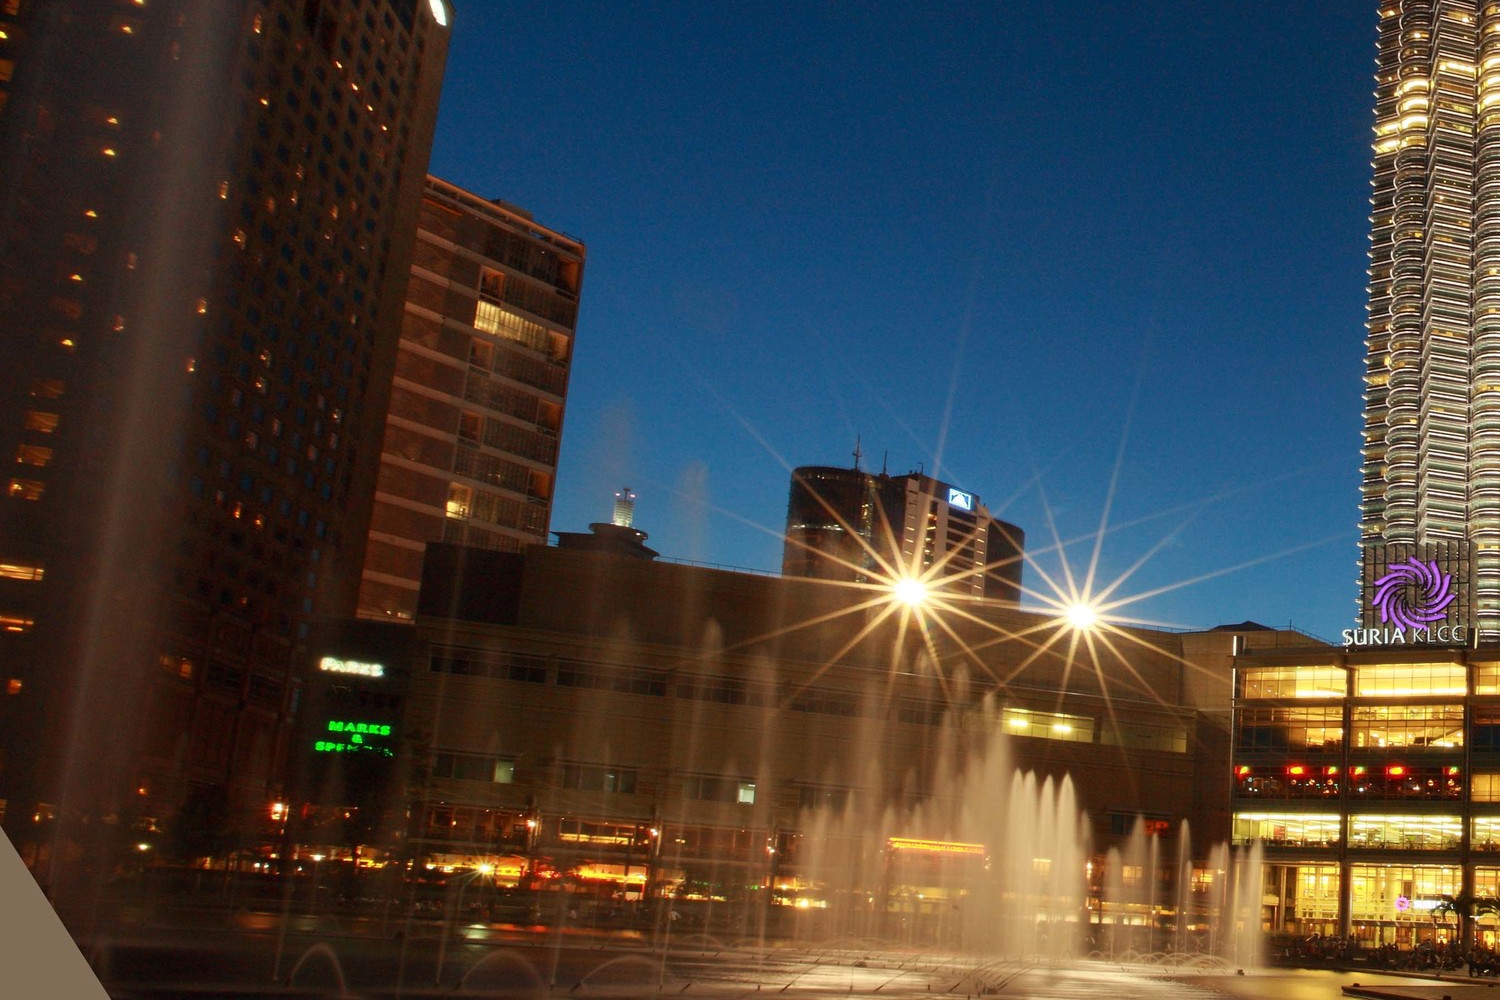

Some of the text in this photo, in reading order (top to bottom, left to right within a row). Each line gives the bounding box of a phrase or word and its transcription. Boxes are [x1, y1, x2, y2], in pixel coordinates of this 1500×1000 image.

[1342, 625, 1465, 646] SURIA KLCC
[328, 720, 391, 736] MARKS
